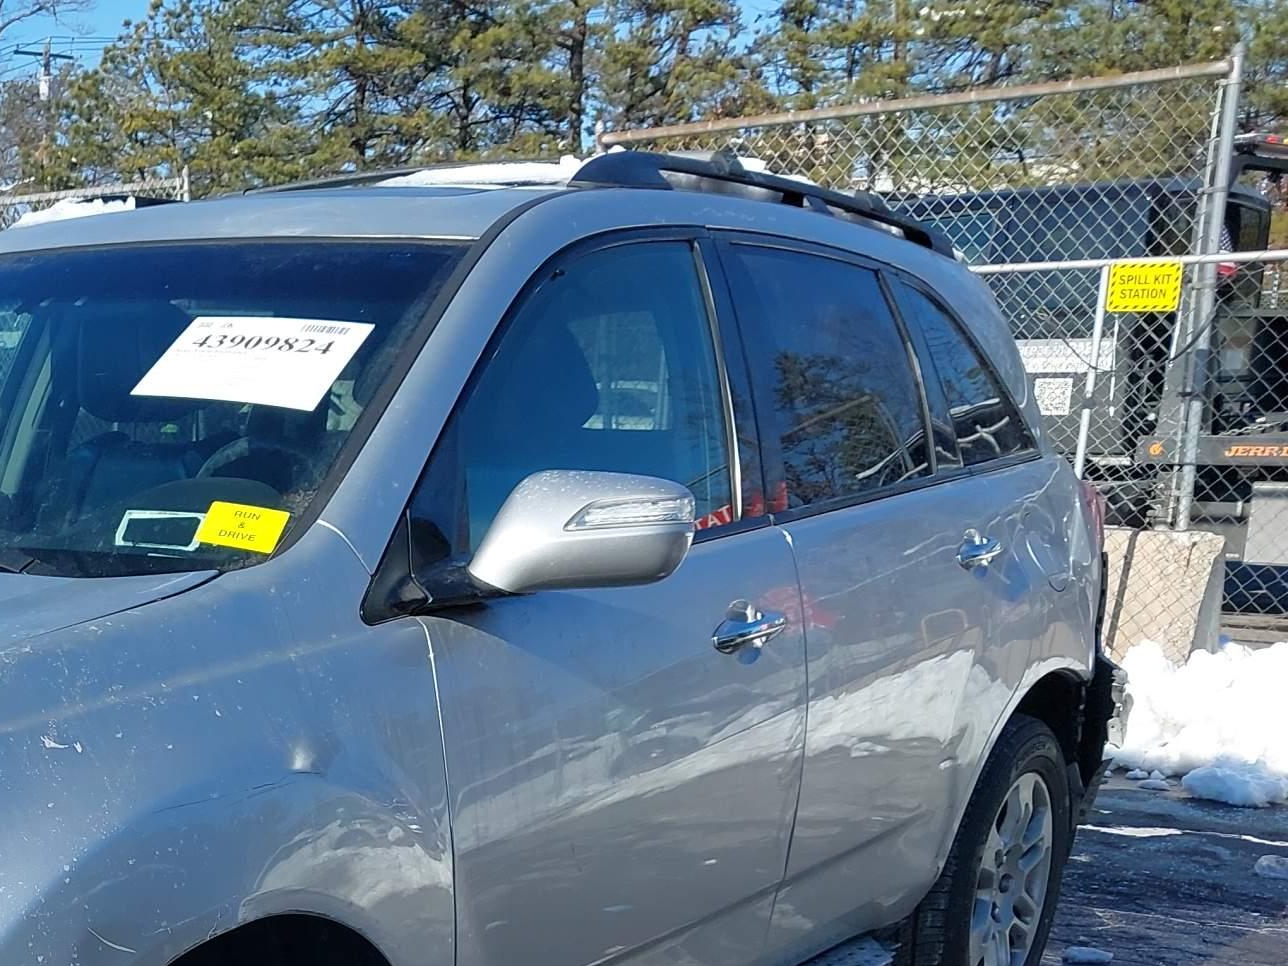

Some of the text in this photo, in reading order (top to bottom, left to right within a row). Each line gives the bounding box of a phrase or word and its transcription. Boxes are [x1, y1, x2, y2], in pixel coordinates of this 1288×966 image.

[1118, 273, 1172, 286] SPILL KIT
[1119, 288, 1167, 300] STATION
[191, 333, 337, 355] 43909824
[233, 510, 261, 521] RUN
[217, 529, 257, 542] DRIVE
